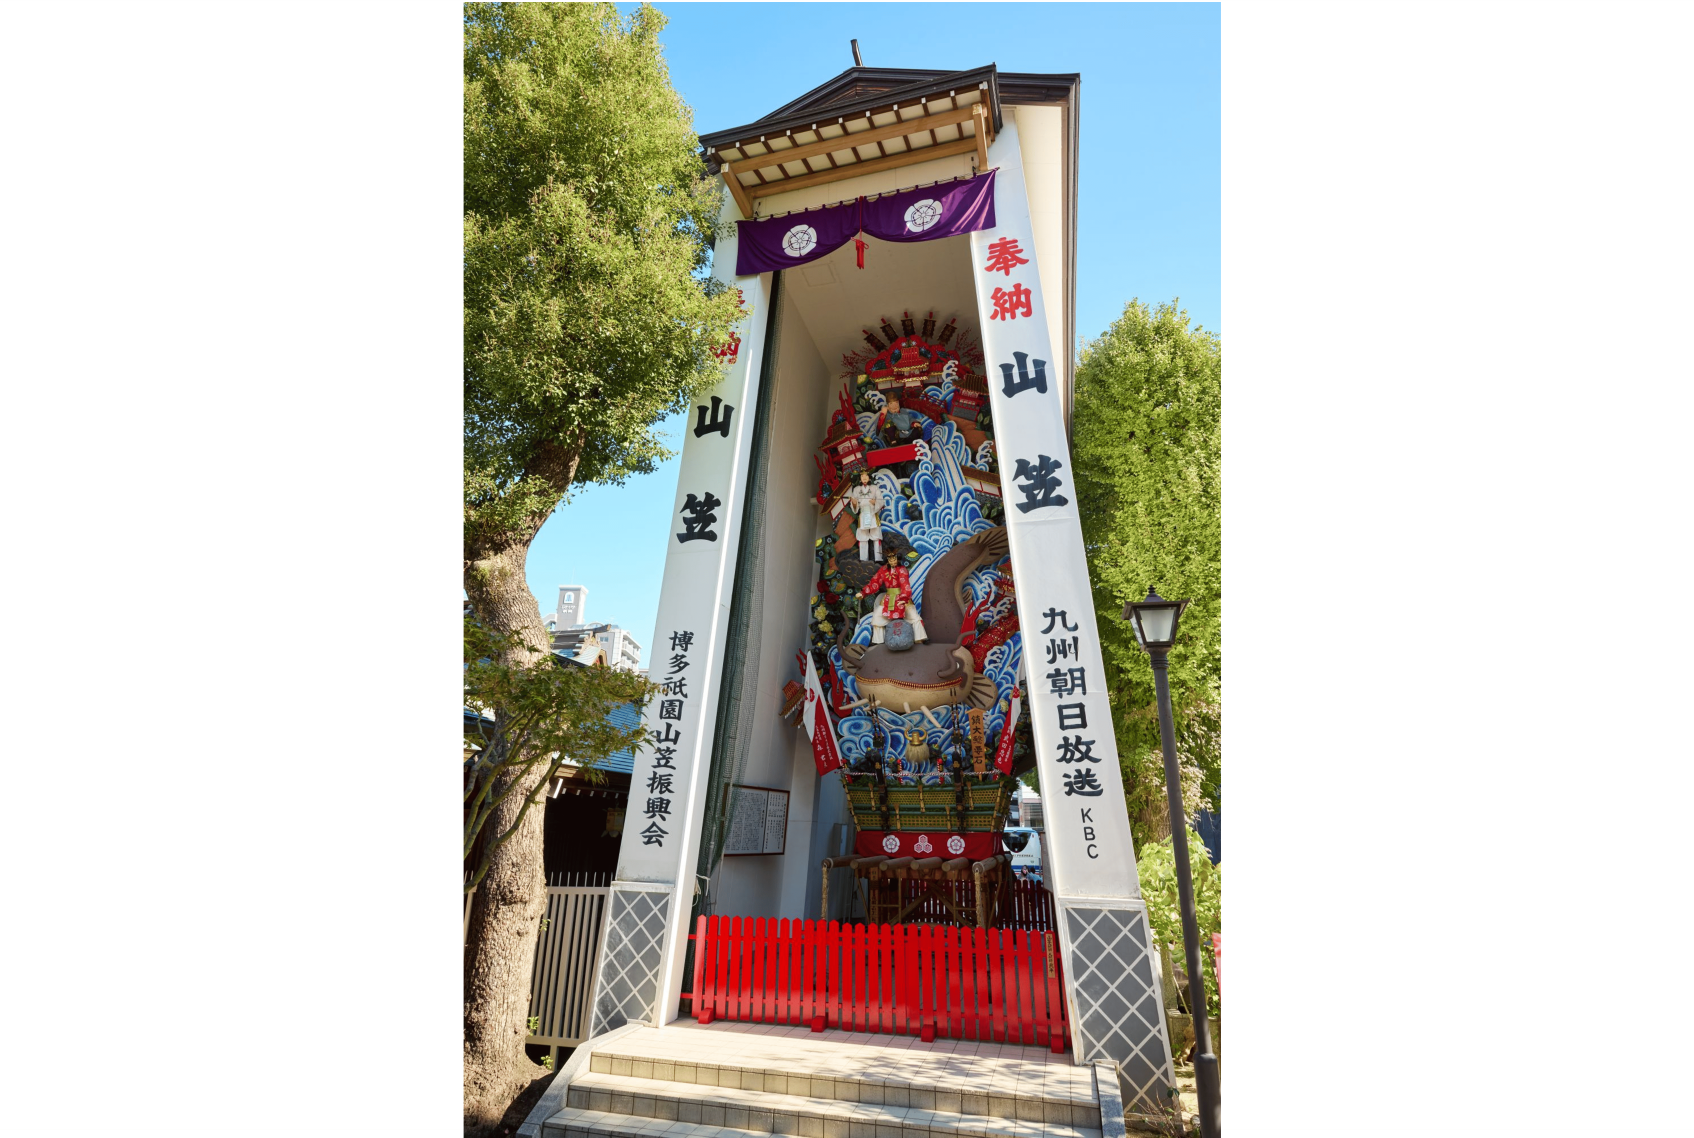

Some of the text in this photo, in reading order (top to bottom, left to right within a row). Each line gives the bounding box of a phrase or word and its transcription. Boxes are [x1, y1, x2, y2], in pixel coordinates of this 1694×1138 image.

[640, 630, 694, 848] 博多祇園山笠振興会
[1040, 607, 1104, 797] 九州朝日放送
[1080, 808, 1099, 860] KBC
